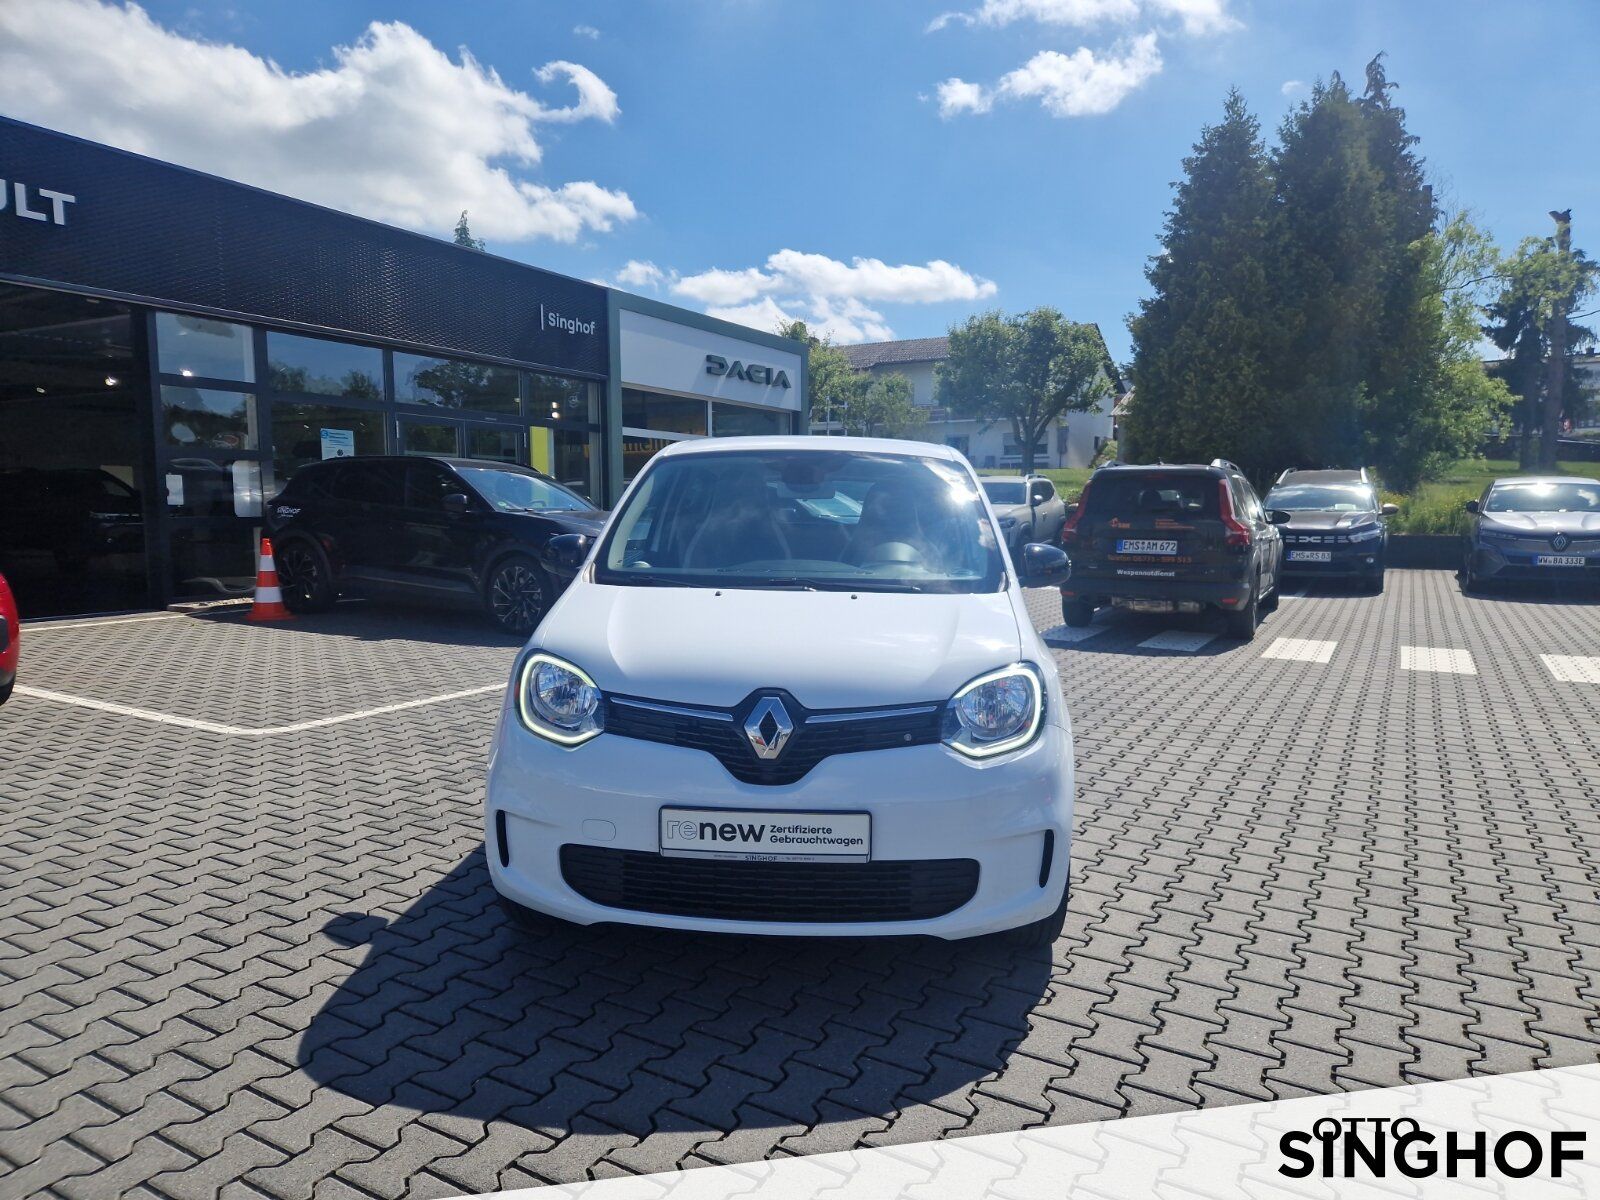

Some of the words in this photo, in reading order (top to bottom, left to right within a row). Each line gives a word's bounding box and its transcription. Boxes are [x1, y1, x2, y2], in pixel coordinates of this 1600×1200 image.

[0, 178, 76, 226] LT
[548, 311, 596, 336] Singhof
[705, 354, 792, 389] DACIA
[1123, 541, 1140, 551] EMS
[1146, 541, 1158, 551] AM
[1160, 542, 1176, 552] 672
[666, 819, 766, 843] renew
[769, 824, 833, 835] Zertifizierte
[769, 835, 864, 847] Gebrauchtwagen
[744, 854, 778, 862] SINGHOF
